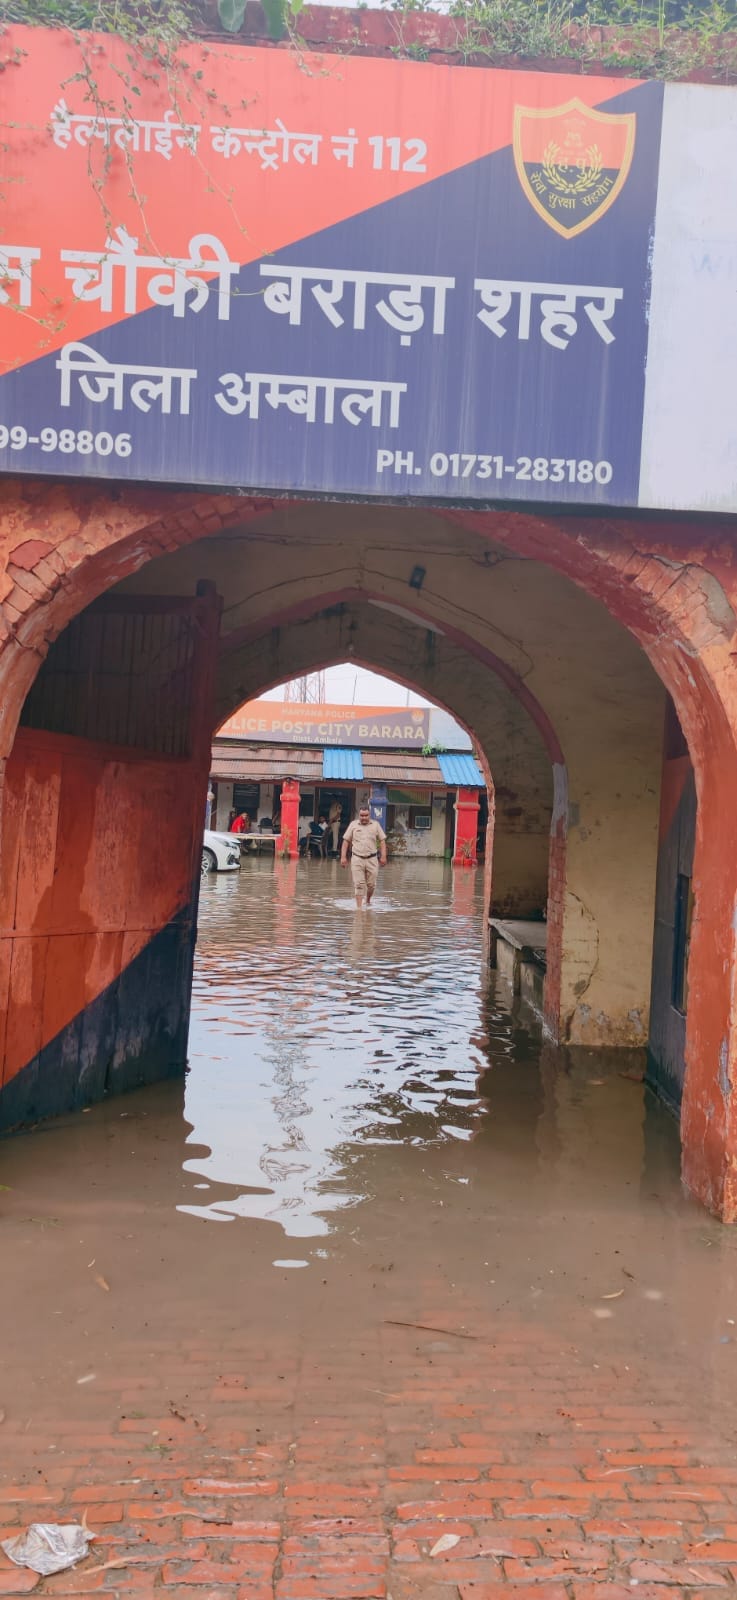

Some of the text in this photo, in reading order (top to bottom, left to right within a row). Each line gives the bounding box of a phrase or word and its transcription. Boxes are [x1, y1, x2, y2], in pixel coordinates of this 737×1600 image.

[209, 117, 323, 171] कन्ट्रोल
[331, 127, 359, 168] नं
[368, 135, 428, 173] 112
[60, 224, 241, 321] चौंकी
[260, 263, 456, 347] बराड़ा
[474, 278, 624, 351] शहर
[55, 341, 407, 428] जिला अम्बाला
[376, 449, 614, 485] PH. 01731-283180
[271, 720, 314, 735] POST
[318, 722, 354, 737] CITY
[358, 725, 426, 739] BARARA
[325, 709, 356, 719] POLICE
